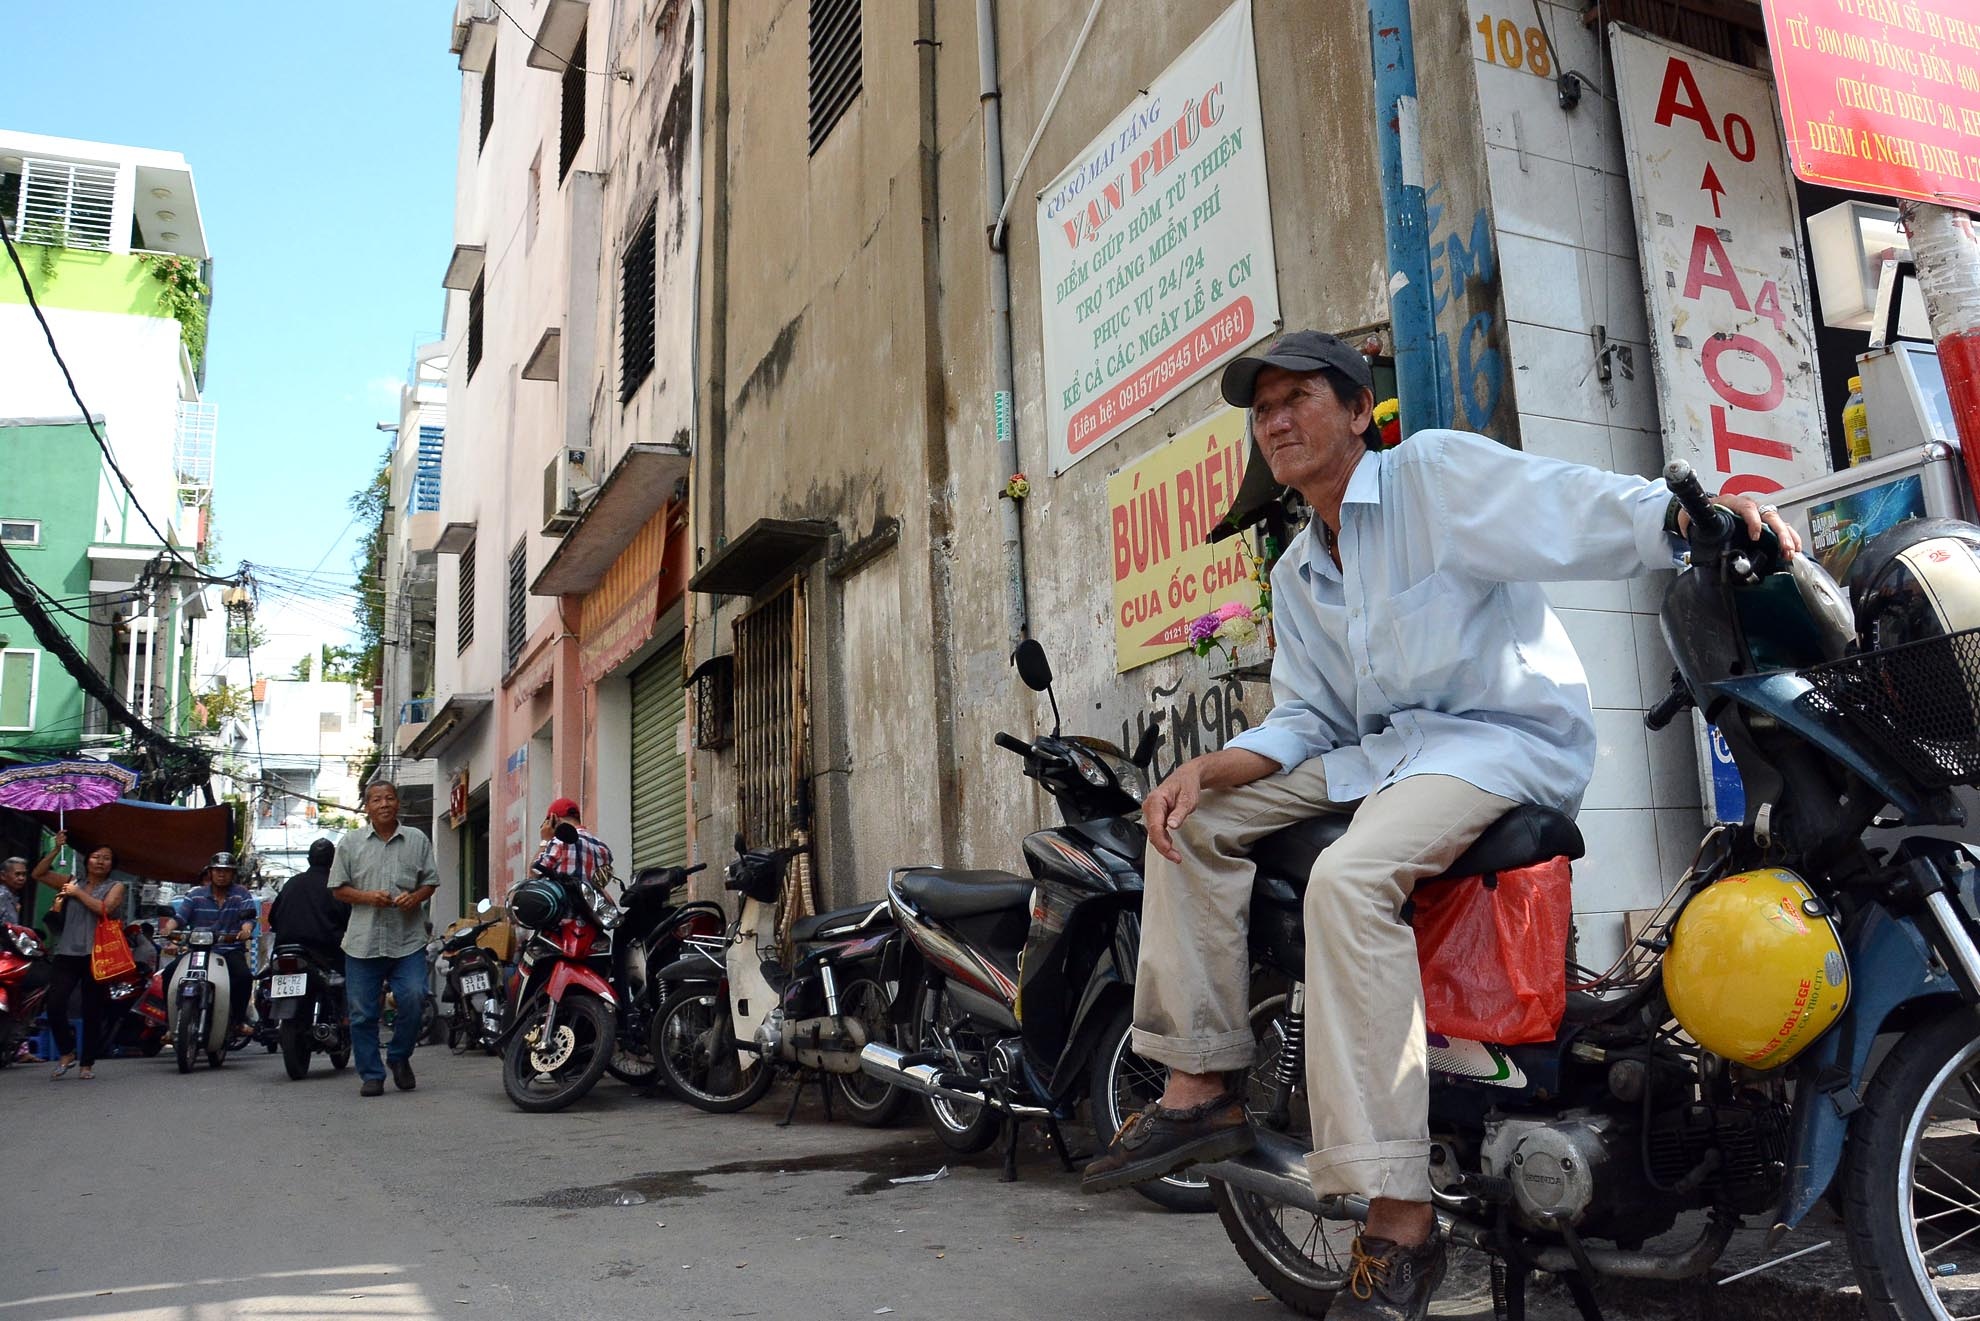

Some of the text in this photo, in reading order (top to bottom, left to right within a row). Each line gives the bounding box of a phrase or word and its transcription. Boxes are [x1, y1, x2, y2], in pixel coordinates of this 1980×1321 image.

[1476, 14, 1551, 78] 108
[1815, 26, 1871, 64] 300.000
[1871, 26, 1919, 77] ĐỒNG
[1919, 44, 1955, 86] ĐẾN
[1925, 11, 1946, 47] BỊ
[1088, 143, 1117, 186] MAI
[1119, 97, 1162, 155] TÁNG
[1835, 74, 1896, 116] (TRÍCH
[1896, 80, 1938, 127] ĐIỀU
[1062, 80, 1225, 249] VẠN PHÚC
[1806, 110, 1858, 158] ĐIỂM
[1860, 131, 1873, 160] d
[1873, 133, 1921, 177] NGHỊ
[1919, 142, 1965, 182] ĐỊNH
[1056, 259, 1089, 305] ĐIỂM
[1092, 231, 1125, 273] GIÚP
[1165, 171, 1186, 210] TỪ
[1191, 126, 1243, 189] THIỆN
[1075, 283, 1102, 325] TRỢ
[1106, 254, 1145, 300] TÁNG
[1192, 183, 1222, 231] PHÍ
[1062, 369, 1082, 411] KỂ
[1085, 358, 1104, 393] CẢ
[1106, 341, 1136, 377] CÁC
[1138, 305, 1180, 356] NGÀY
[1211, 278, 1224, 302] &
[1228, 253, 1251, 289] CN
[1093, 246, 1205, 350] PHỤC VỤ 24/24
[1073, 412, 1097, 442] Liên
[1099, 399, 1117, 425] hệ:
[1119, 342, 1192, 410] 0915779545
[1112, 434, 1245, 583] BÚN RIÊU
[1120, 540, 1248, 629] CUA ỐC CHẢ
[1164, 626, 1182, 641] 0121
[1779, 978, 1811, 1036] COLLEGE
[1814, 968, 1824, 991] CITY
